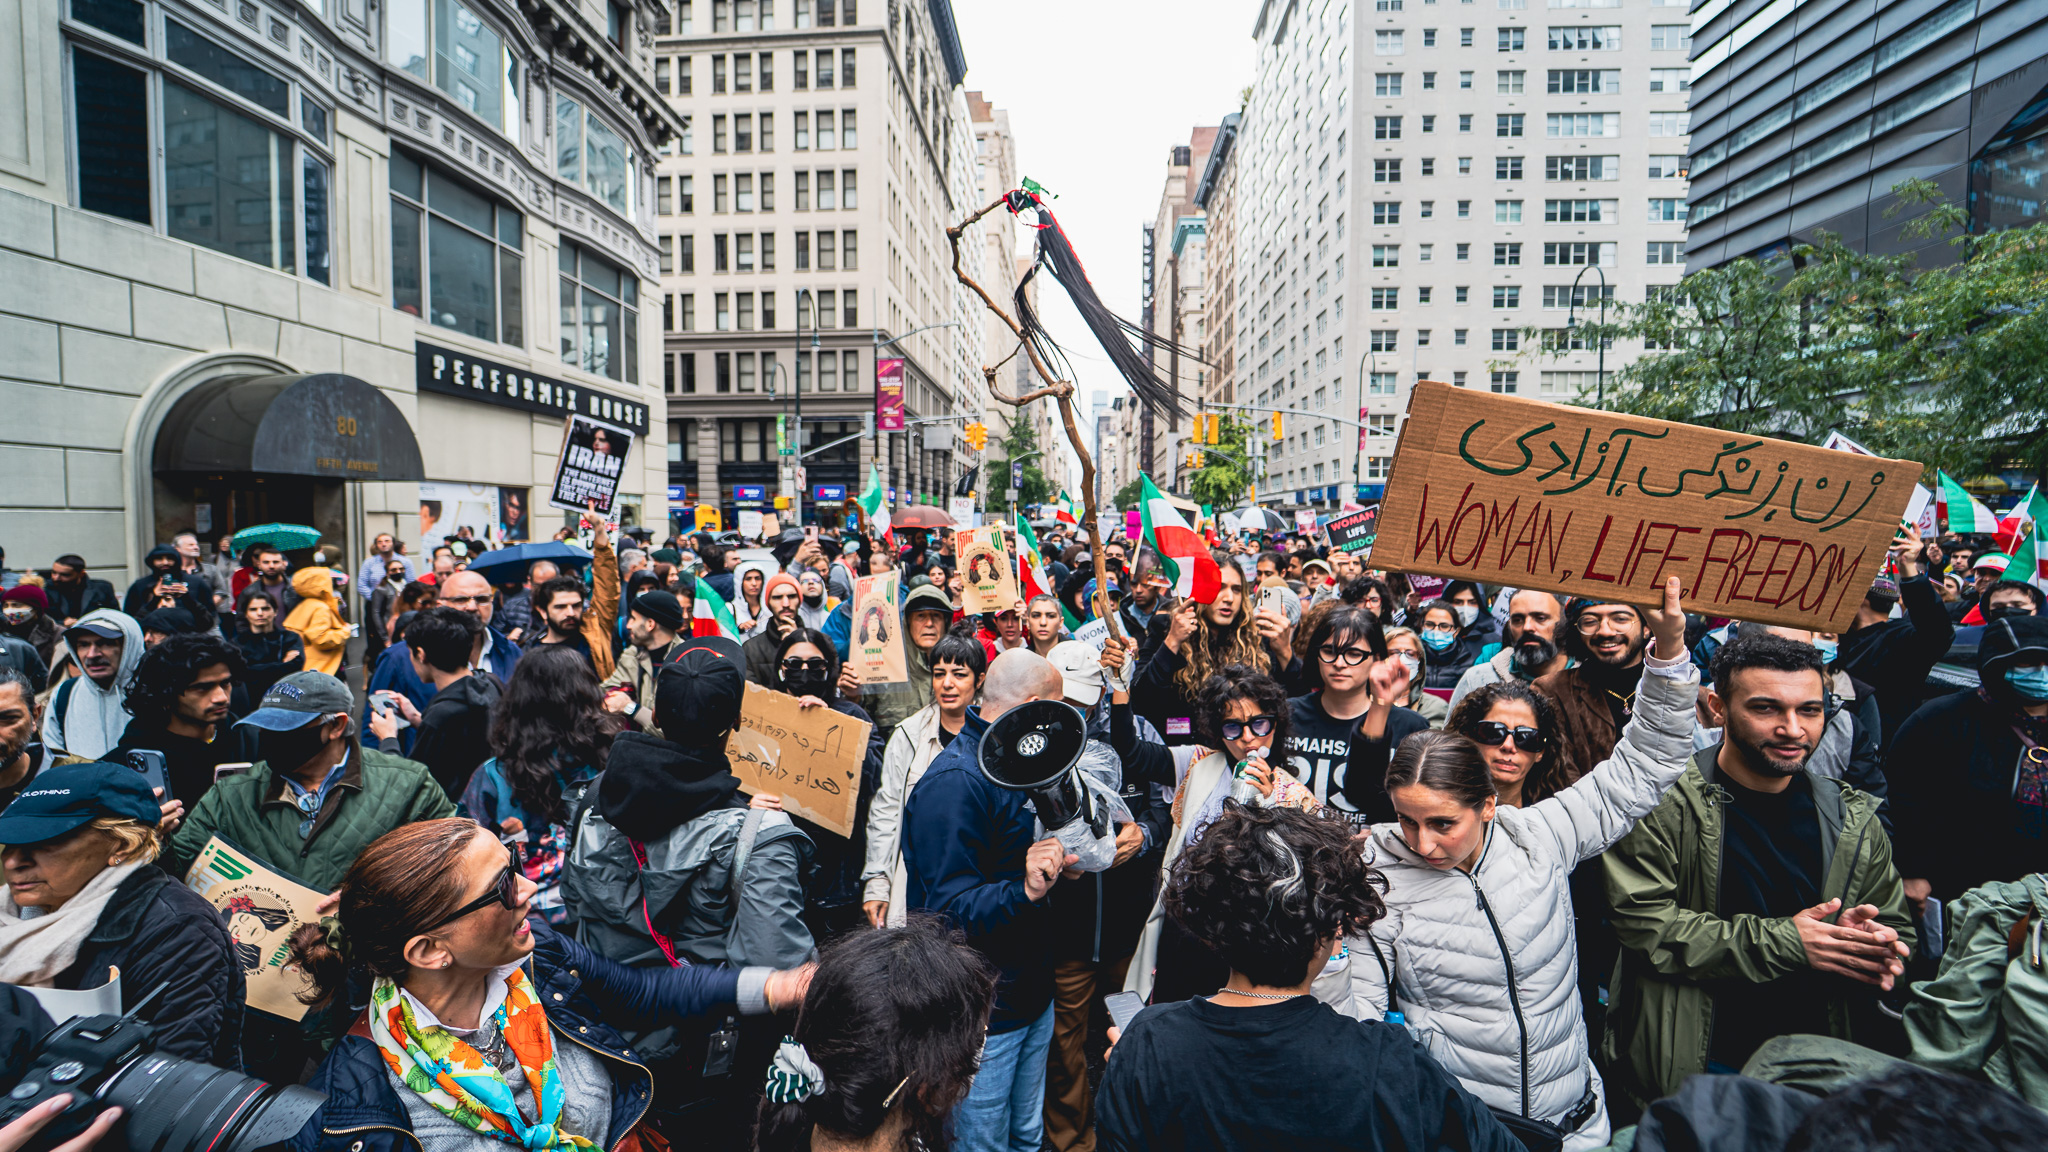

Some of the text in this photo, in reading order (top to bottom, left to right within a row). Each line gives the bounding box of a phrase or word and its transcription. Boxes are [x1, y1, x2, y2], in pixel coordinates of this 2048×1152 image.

[589, 395, 643, 427] HOUSE
[337, 416, 357, 437] 80
[316, 457, 379, 472] FIFTH AVENUE
[568, 444, 621, 478] IRAN
[1459, 418, 1670, 496] آزادی
[564, 467, 580, 478] THE
[955, 500, 969, 508] NO
[1330, 510, 1375, 532] WOMAN
[1345, 525, 1367, 539] LIFE
[1338, 534, 1377, 552] REEDO
[1691, 528, 1867, 622] FREEDOM
[21, 788, 71, 798] CLOTHING
